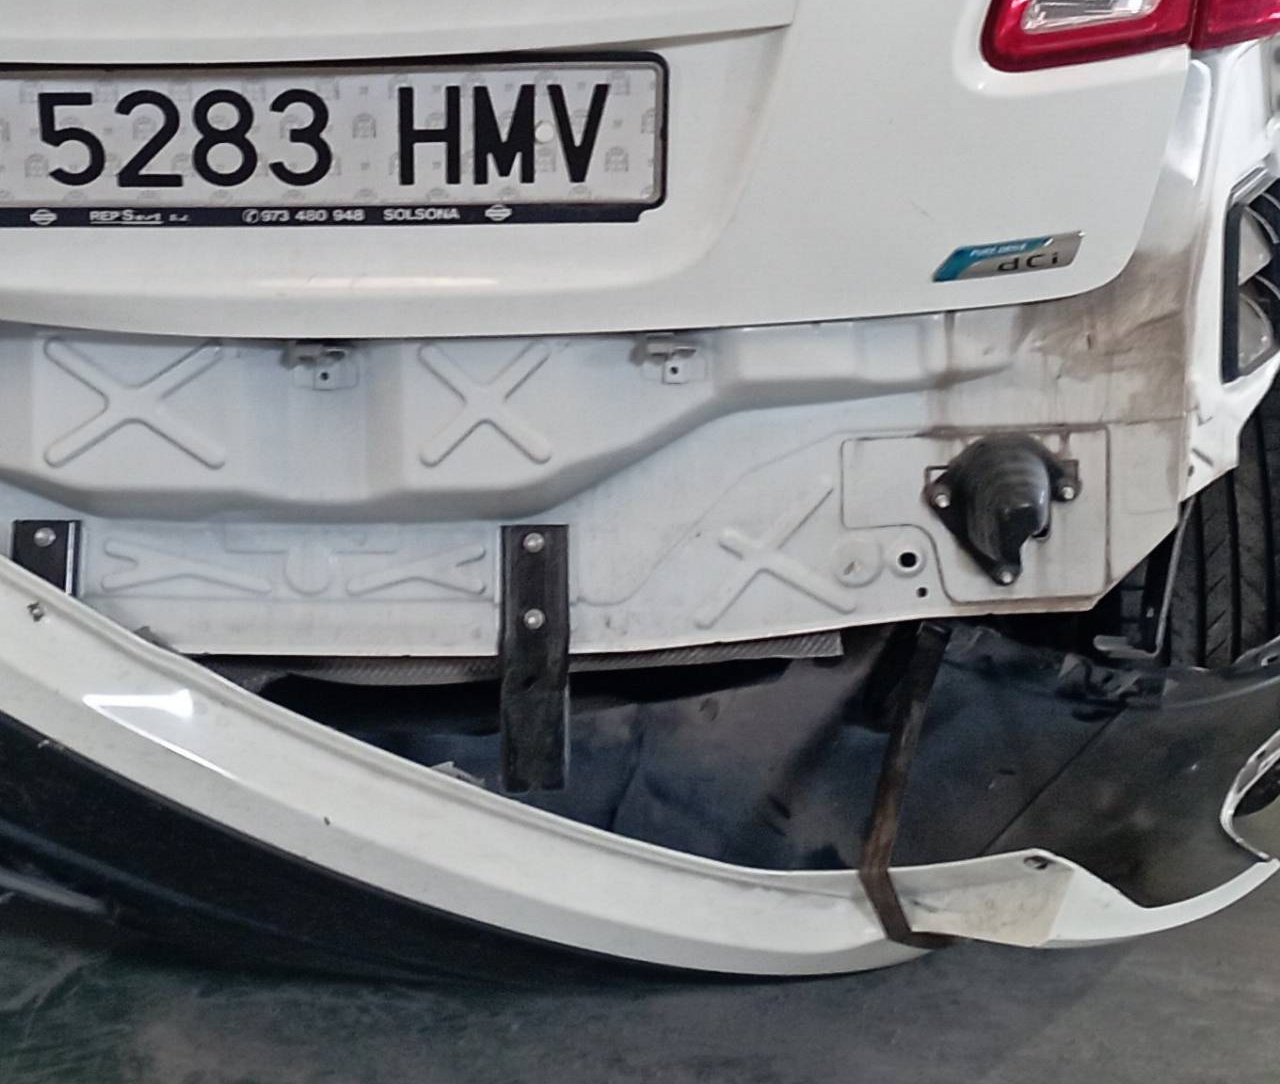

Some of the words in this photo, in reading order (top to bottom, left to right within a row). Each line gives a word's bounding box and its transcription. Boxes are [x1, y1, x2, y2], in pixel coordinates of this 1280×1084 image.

[37, 89, 333, 188] 5283
[398, 82, 610, 186] HMV
[260, 209, 290, 222] 973
[294, 209, 328, 222] 480
[332, 208, 366, 221] 948
[382, 207, 461, 221] SOLSONA
[996, 251, 1059, 272] dCi
